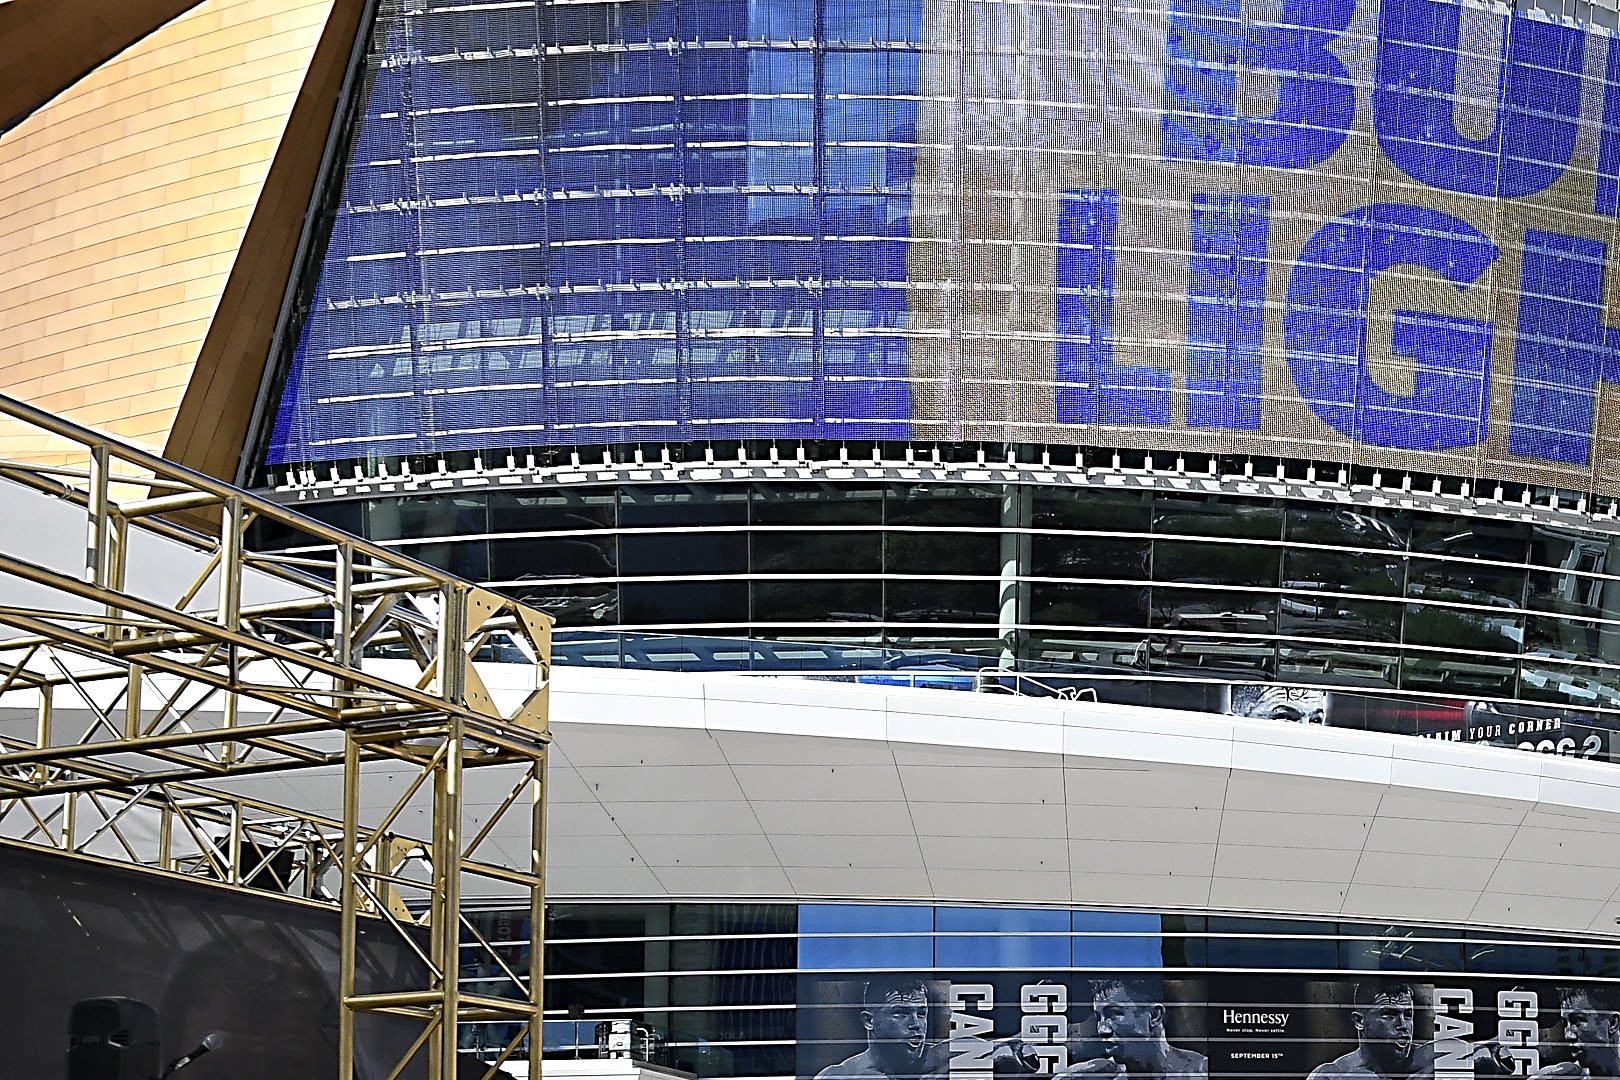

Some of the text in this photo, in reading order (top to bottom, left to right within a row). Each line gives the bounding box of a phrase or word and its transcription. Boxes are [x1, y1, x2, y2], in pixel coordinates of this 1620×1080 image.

[1469, 724, 1501, 740] YOUR
[1508, 717, 1562, 735] CORNER
[1223, 1009, 1290, 1027] Hennessy
